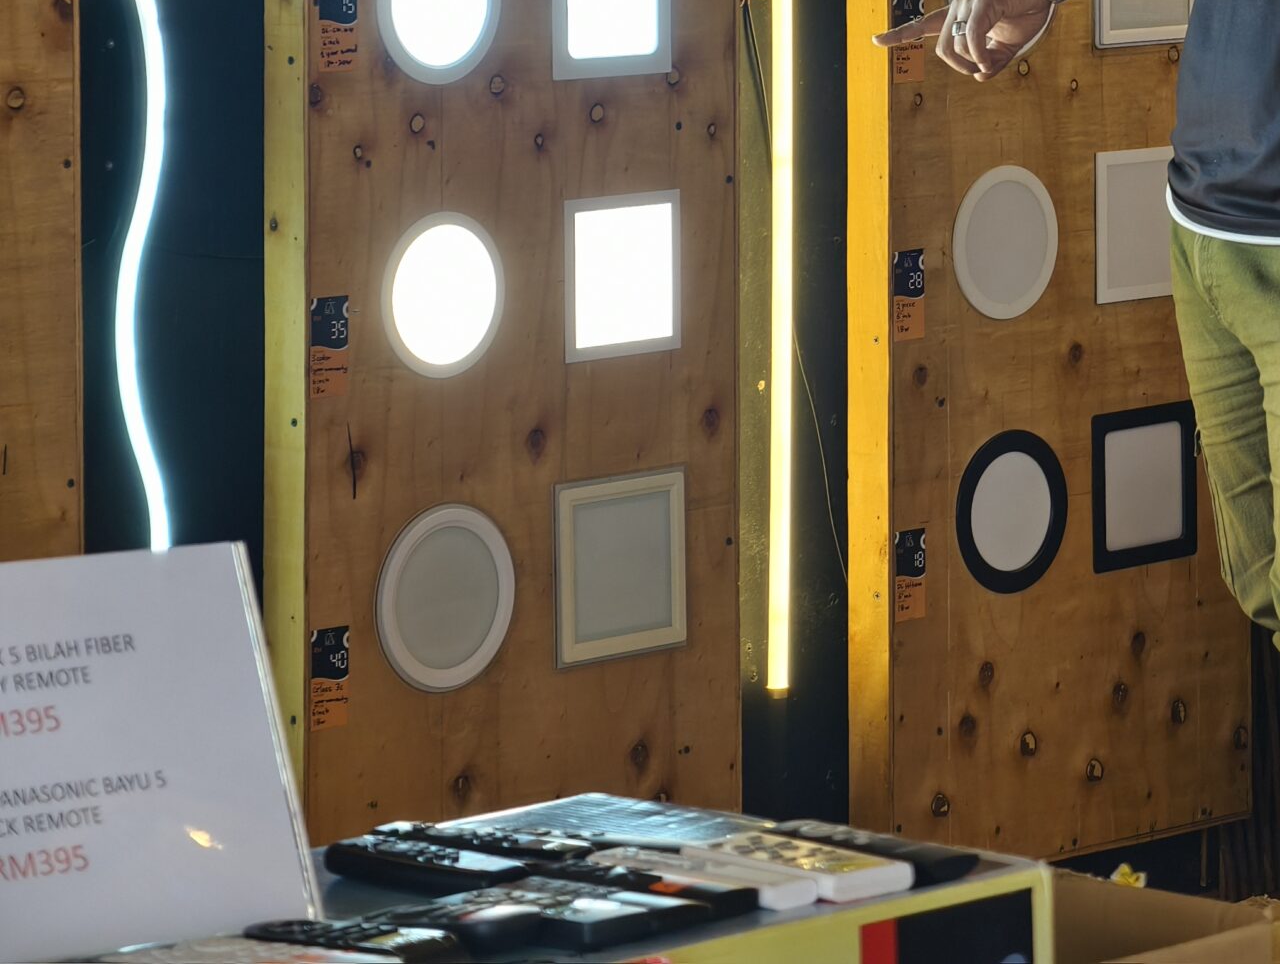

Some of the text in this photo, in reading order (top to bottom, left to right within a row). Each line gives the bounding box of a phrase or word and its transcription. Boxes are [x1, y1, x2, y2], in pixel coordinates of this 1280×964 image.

[908, 271, 922, 289] 28
[330, 320, 347, 339] 35
[914, 550, 924, 568] 18
[8, 646, 19, 665] 5
[25, 640, 80, 663] BILAH
[85, 633, 136, 656] FIBER
[330, 650, 347, 669] 40
[13, 665, 92, 692] REMOTE
[102, 772, 153, 795] BAYU
[154, 770, 168, 788] 5
[23, 805, 103, 834] REMOTE
